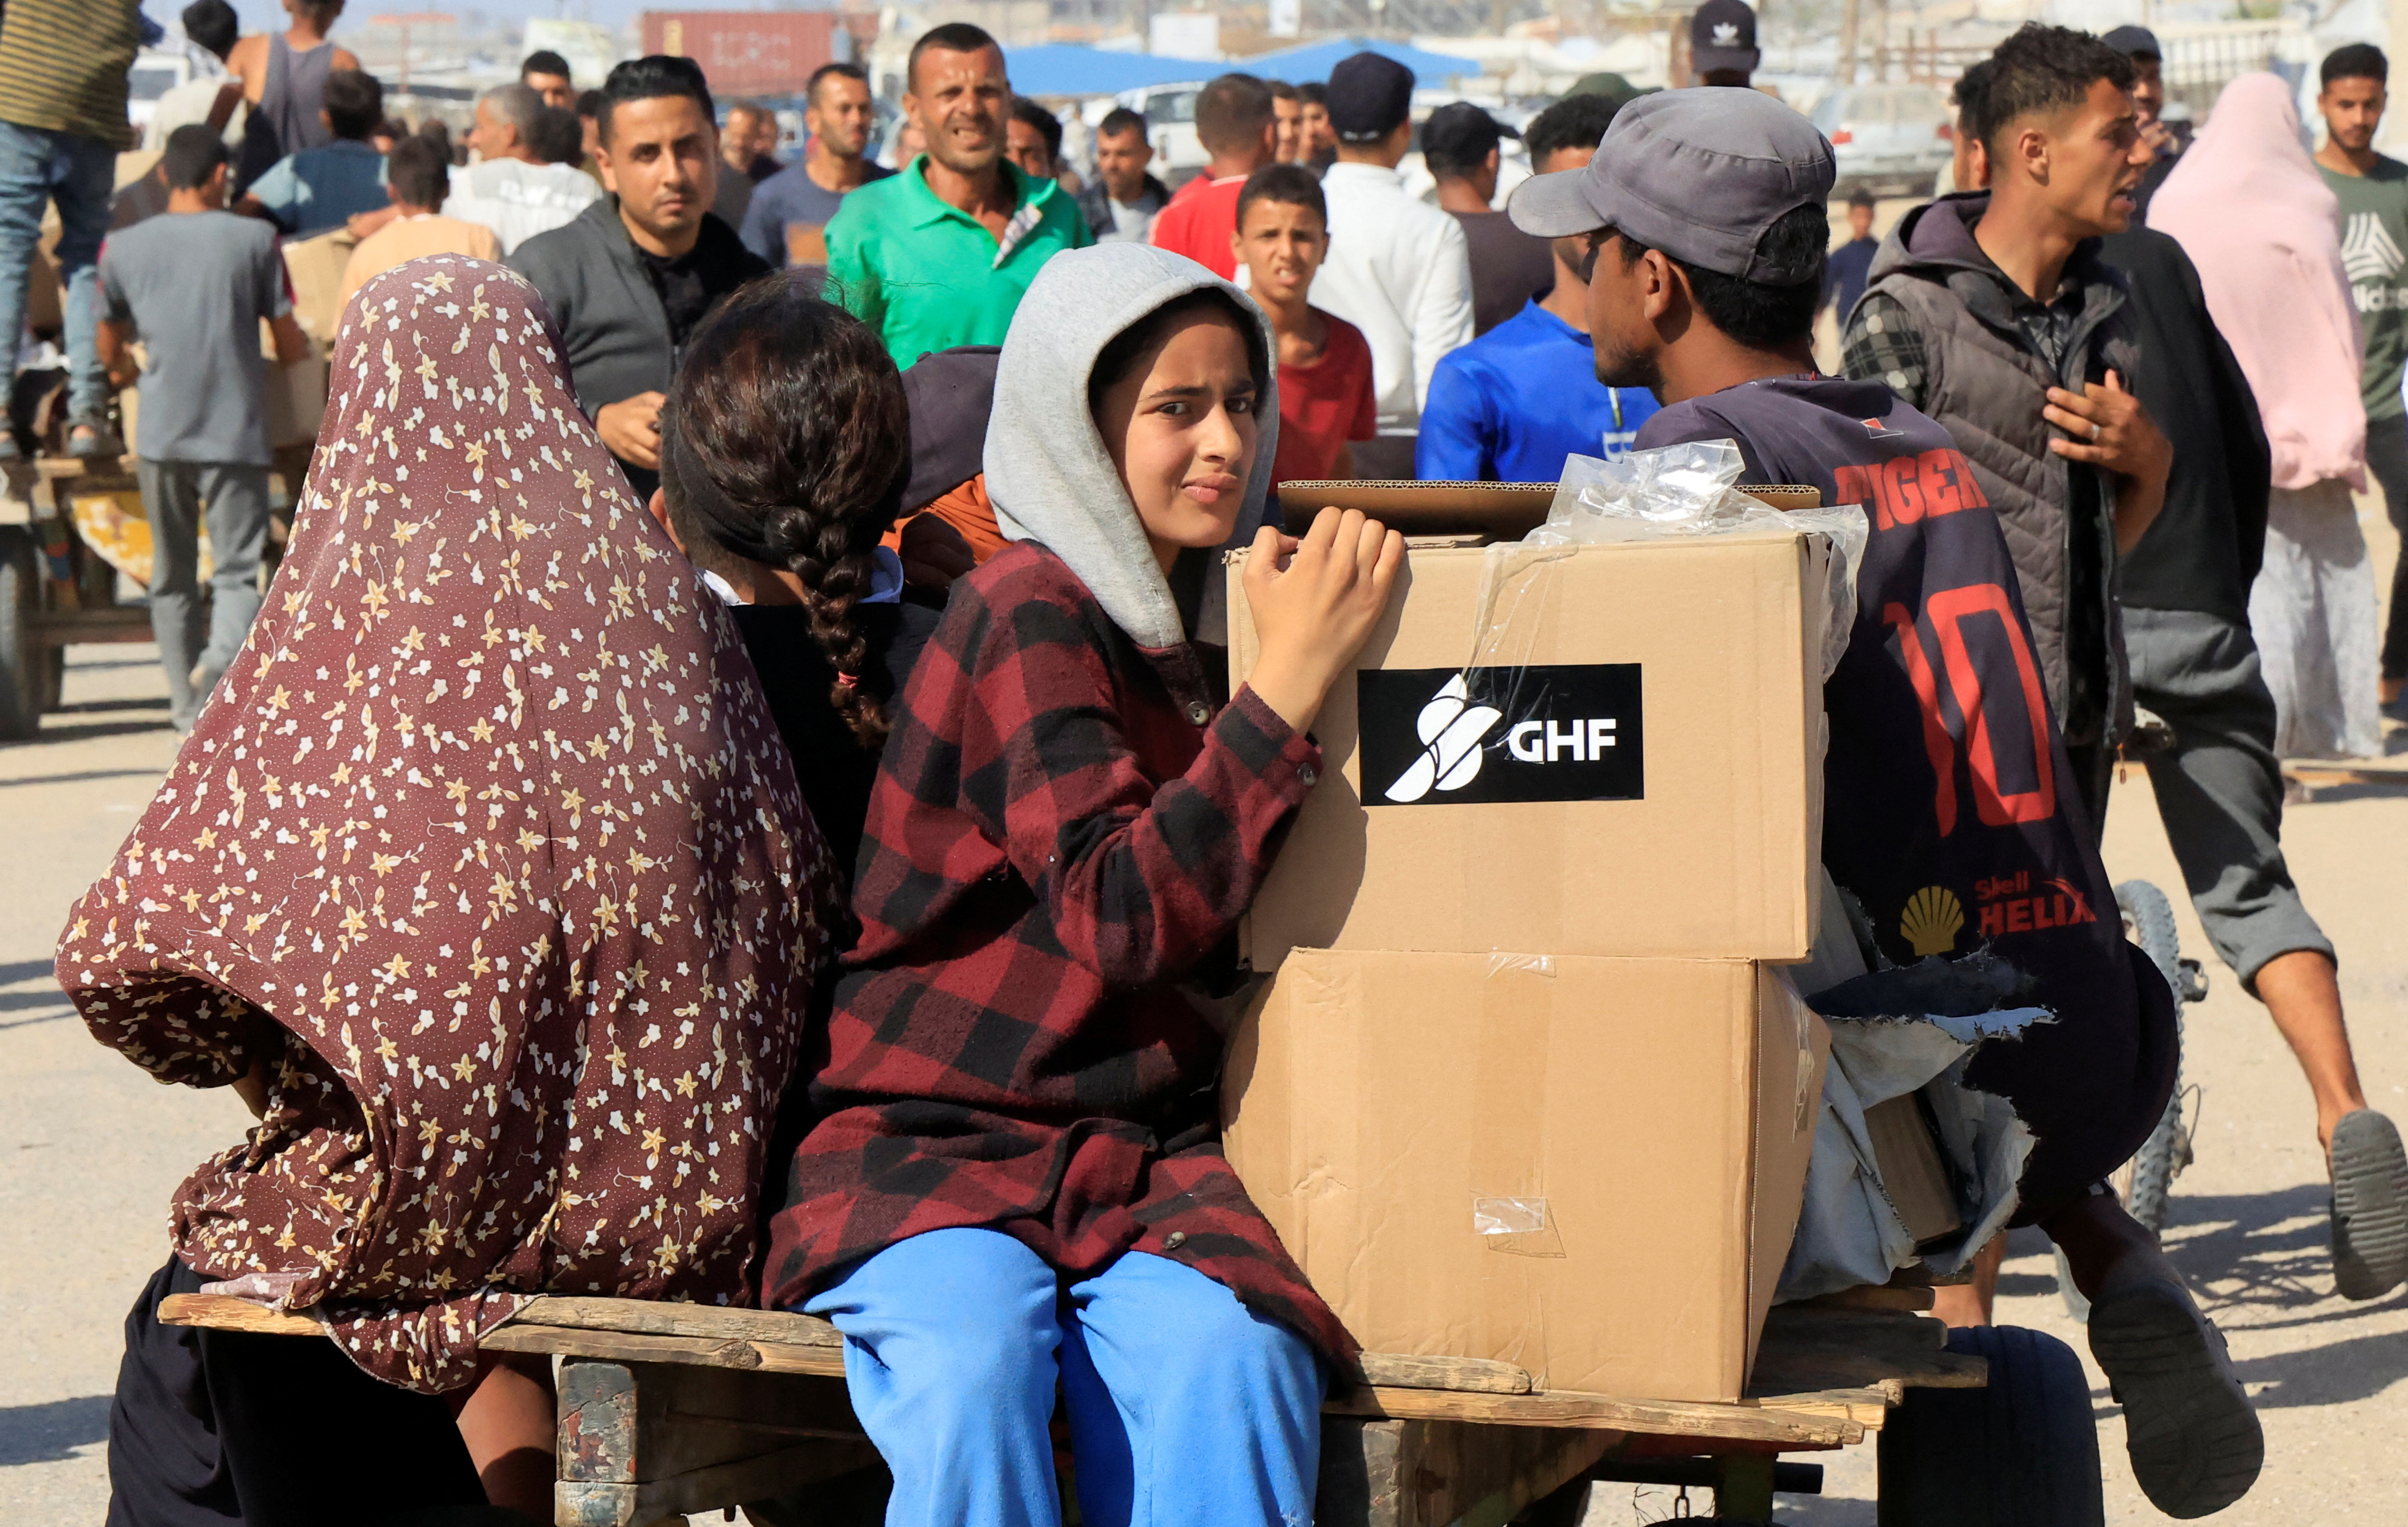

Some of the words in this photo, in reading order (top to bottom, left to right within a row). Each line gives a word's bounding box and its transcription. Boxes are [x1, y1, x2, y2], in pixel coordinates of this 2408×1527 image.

[1883, 583, 2055, 837] 10
[1509, 719, 1616, 762] GHF
[1978, 878, 2097, 937] HELIX
